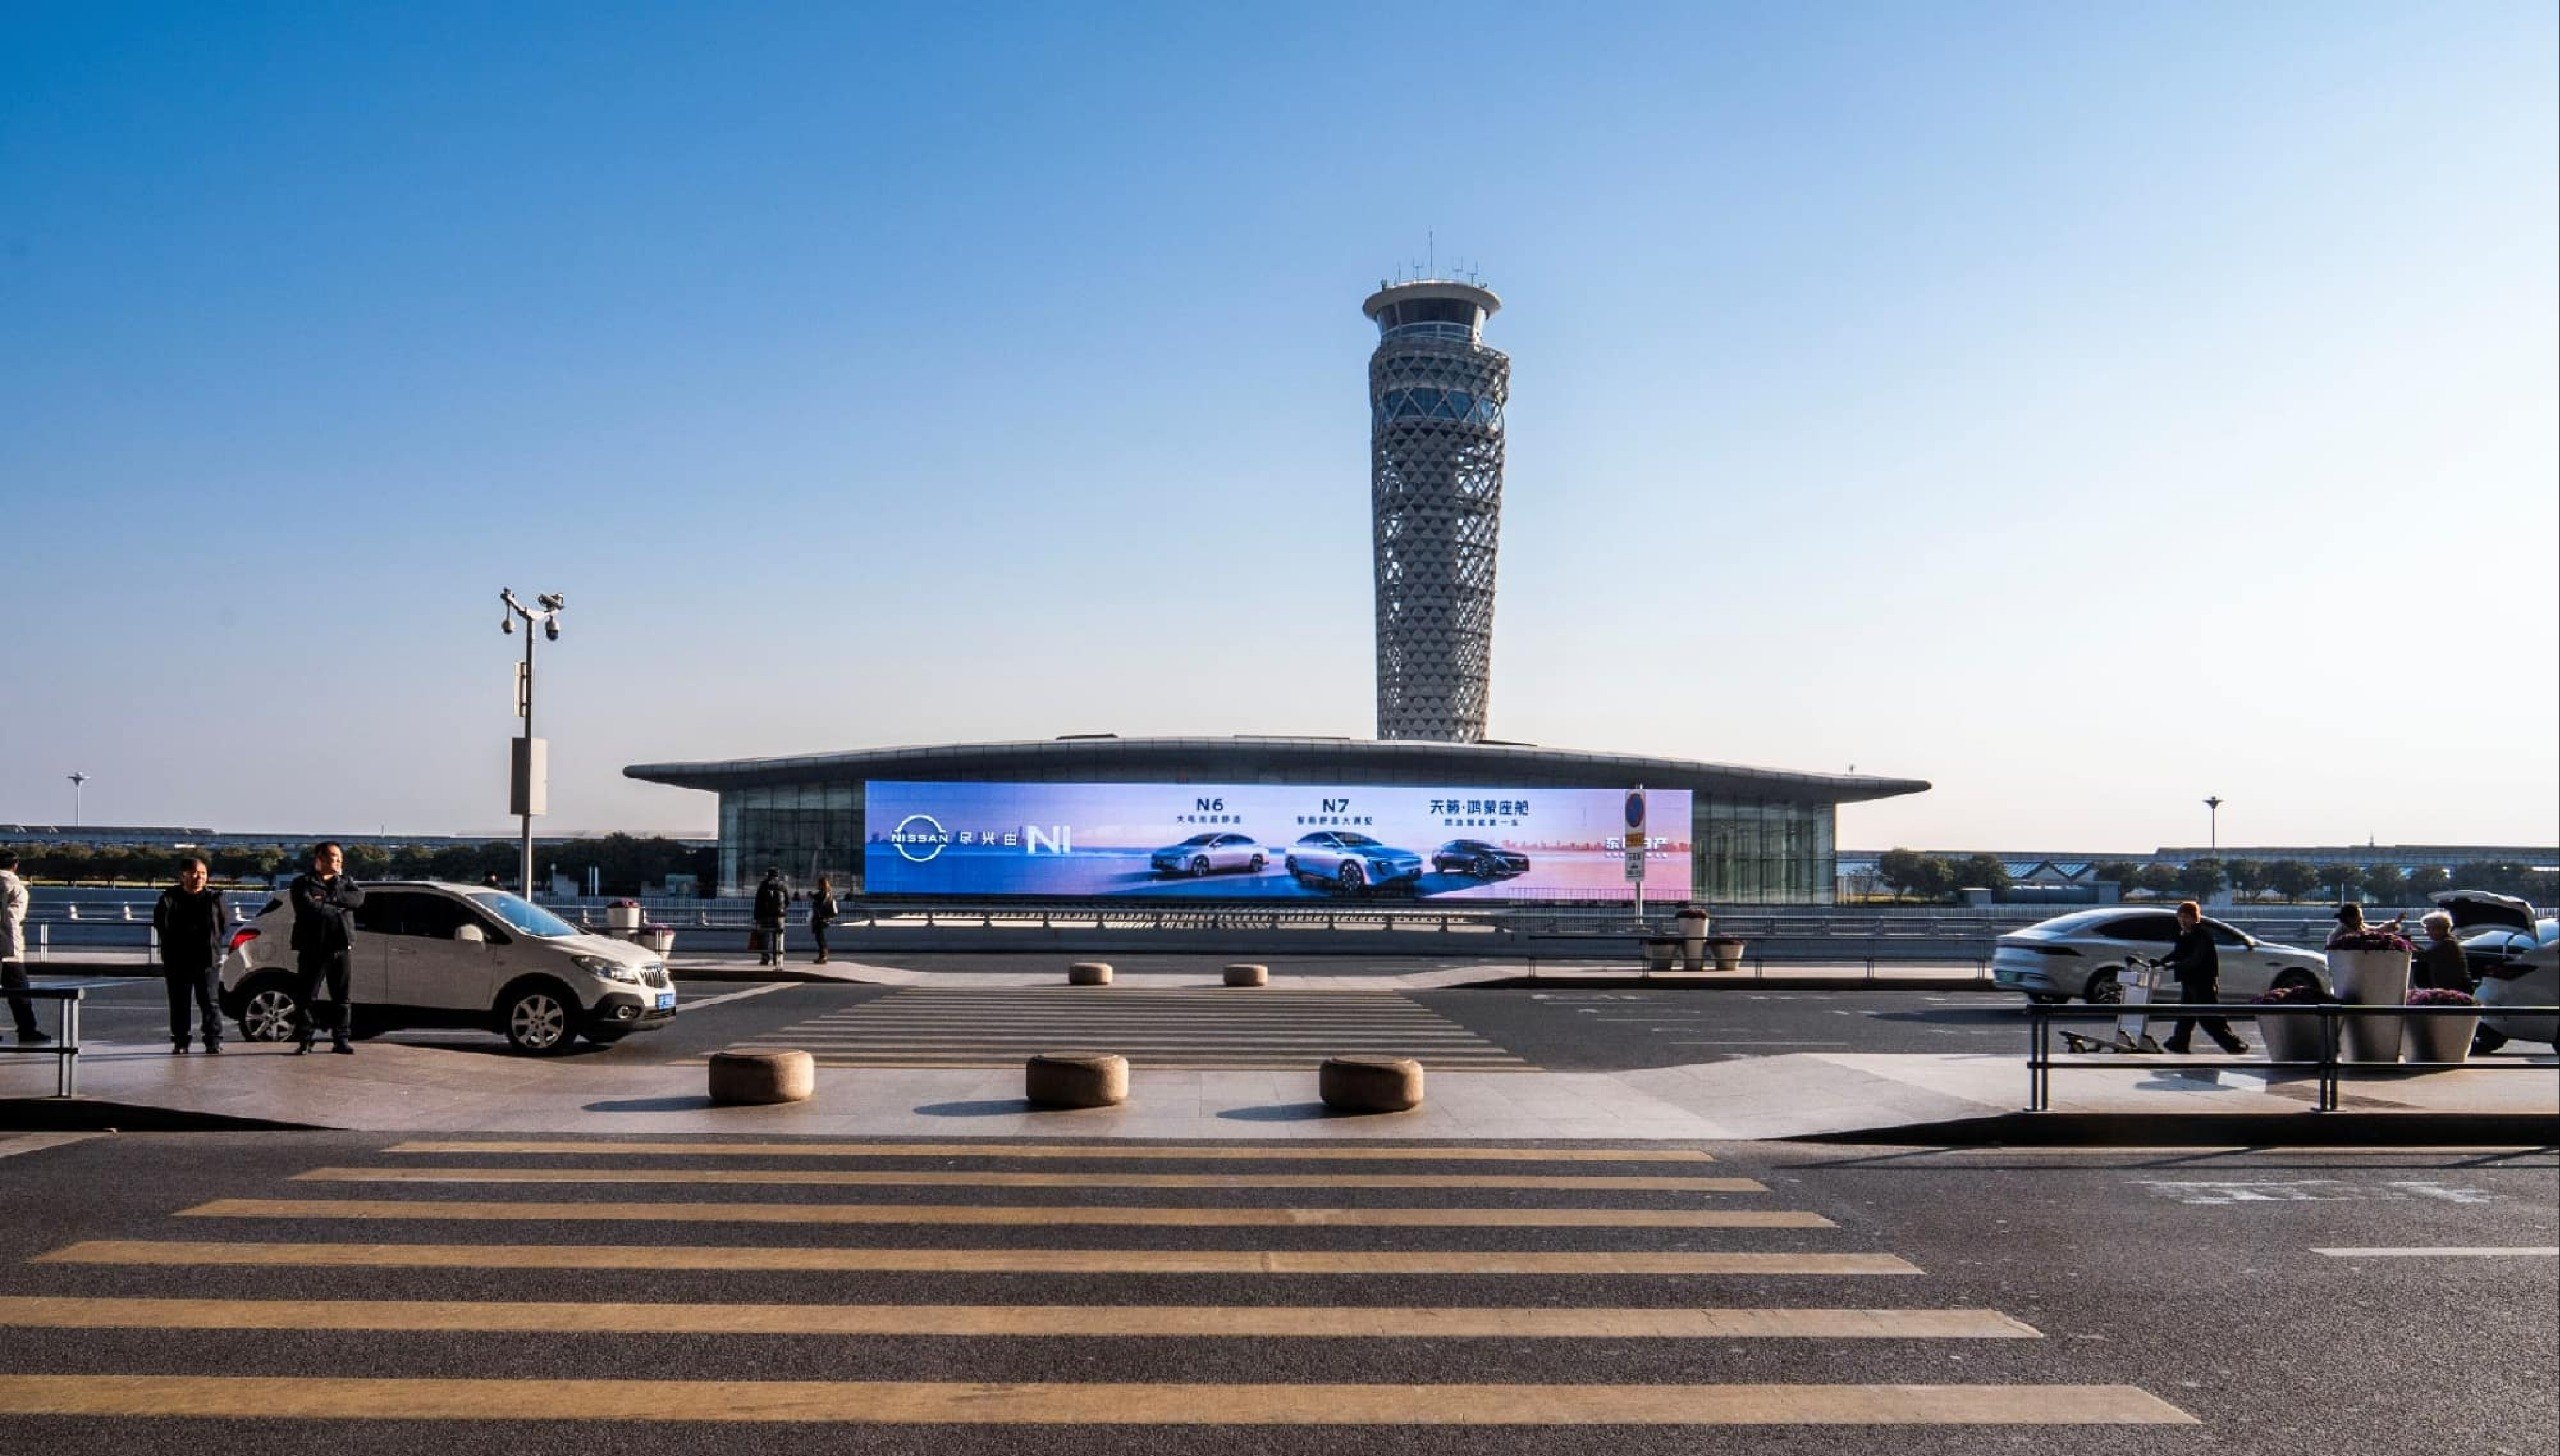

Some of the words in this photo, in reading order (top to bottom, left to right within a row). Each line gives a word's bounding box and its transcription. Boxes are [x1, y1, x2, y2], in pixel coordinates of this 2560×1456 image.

[1197, 798, 1224, 811] N6
[1322, 798, 1350, 813] N7
[891, 834, 949, 844] NISSAN
[1027, 825, 1071, 854] NI
[1606, 837, 1668, 850] 东日产
